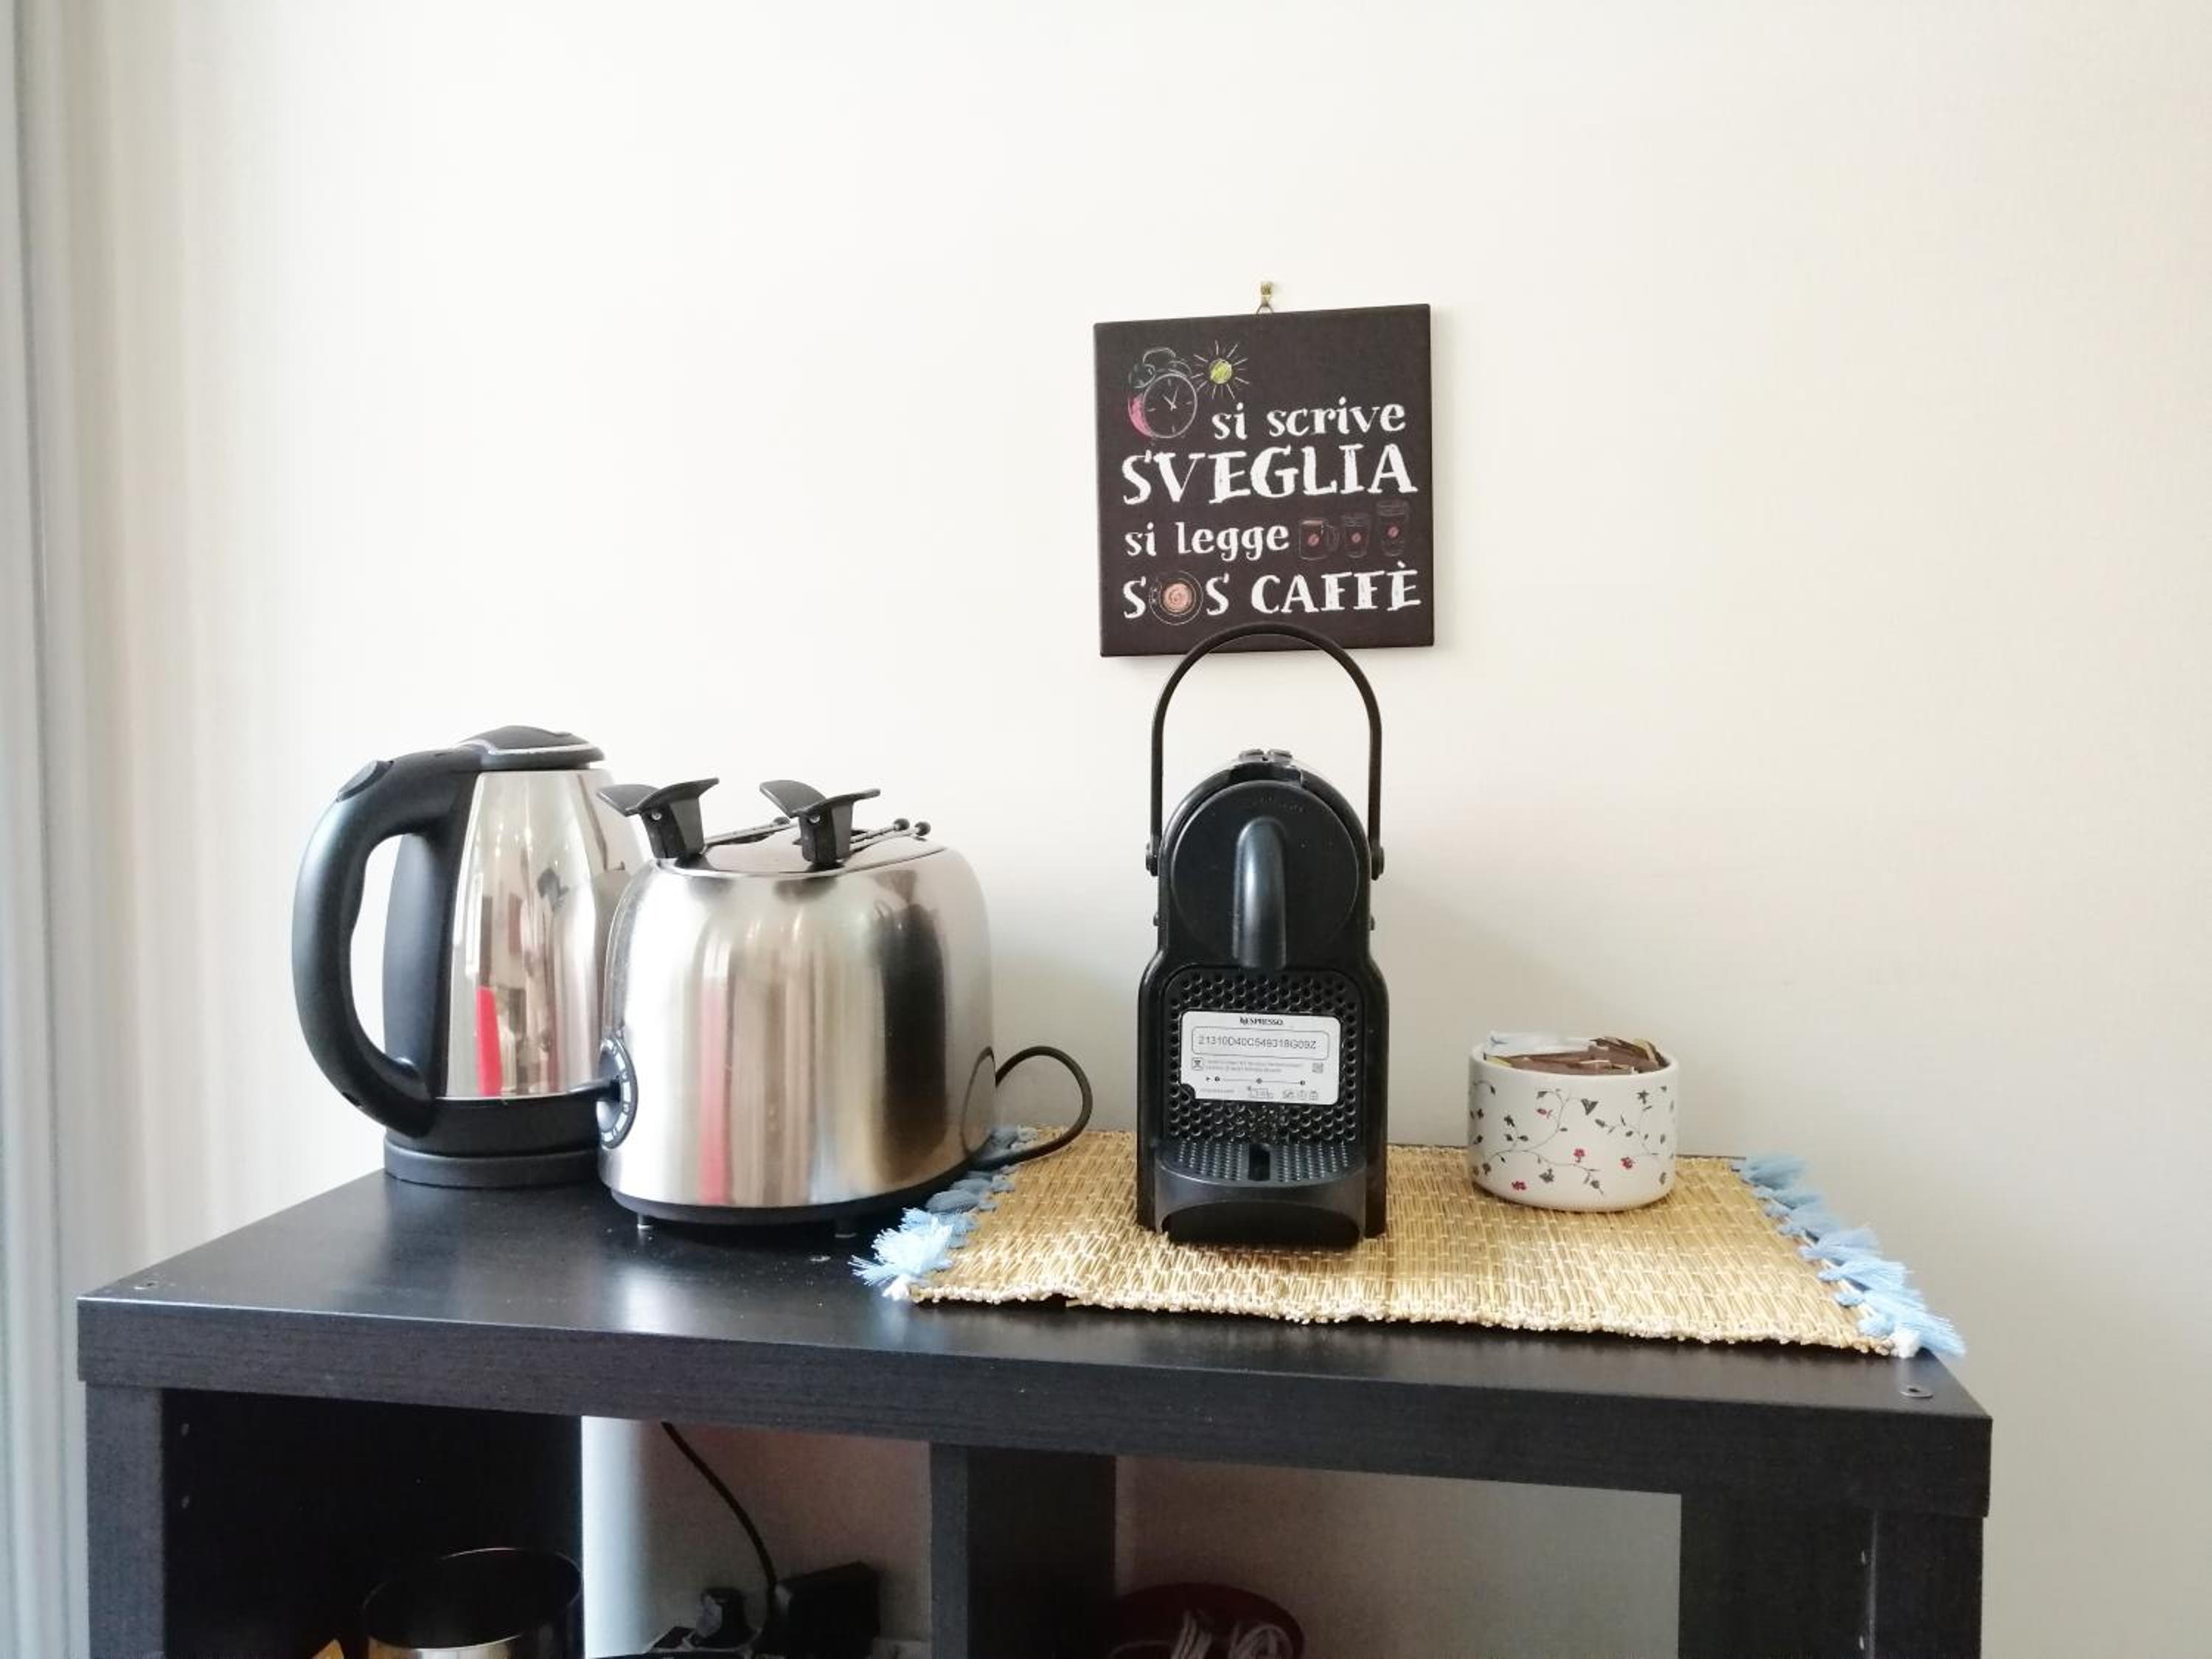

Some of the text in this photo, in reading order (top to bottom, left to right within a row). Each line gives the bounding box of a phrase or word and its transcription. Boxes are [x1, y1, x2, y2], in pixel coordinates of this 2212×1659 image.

[1211, 396, 1407, 440] si scrive
[1121, 442, 1419, 505] SVEGLIA
[1124, 521, 1290, 562] si legge
[1250, 560, 1422, 615] CAFFÈ
